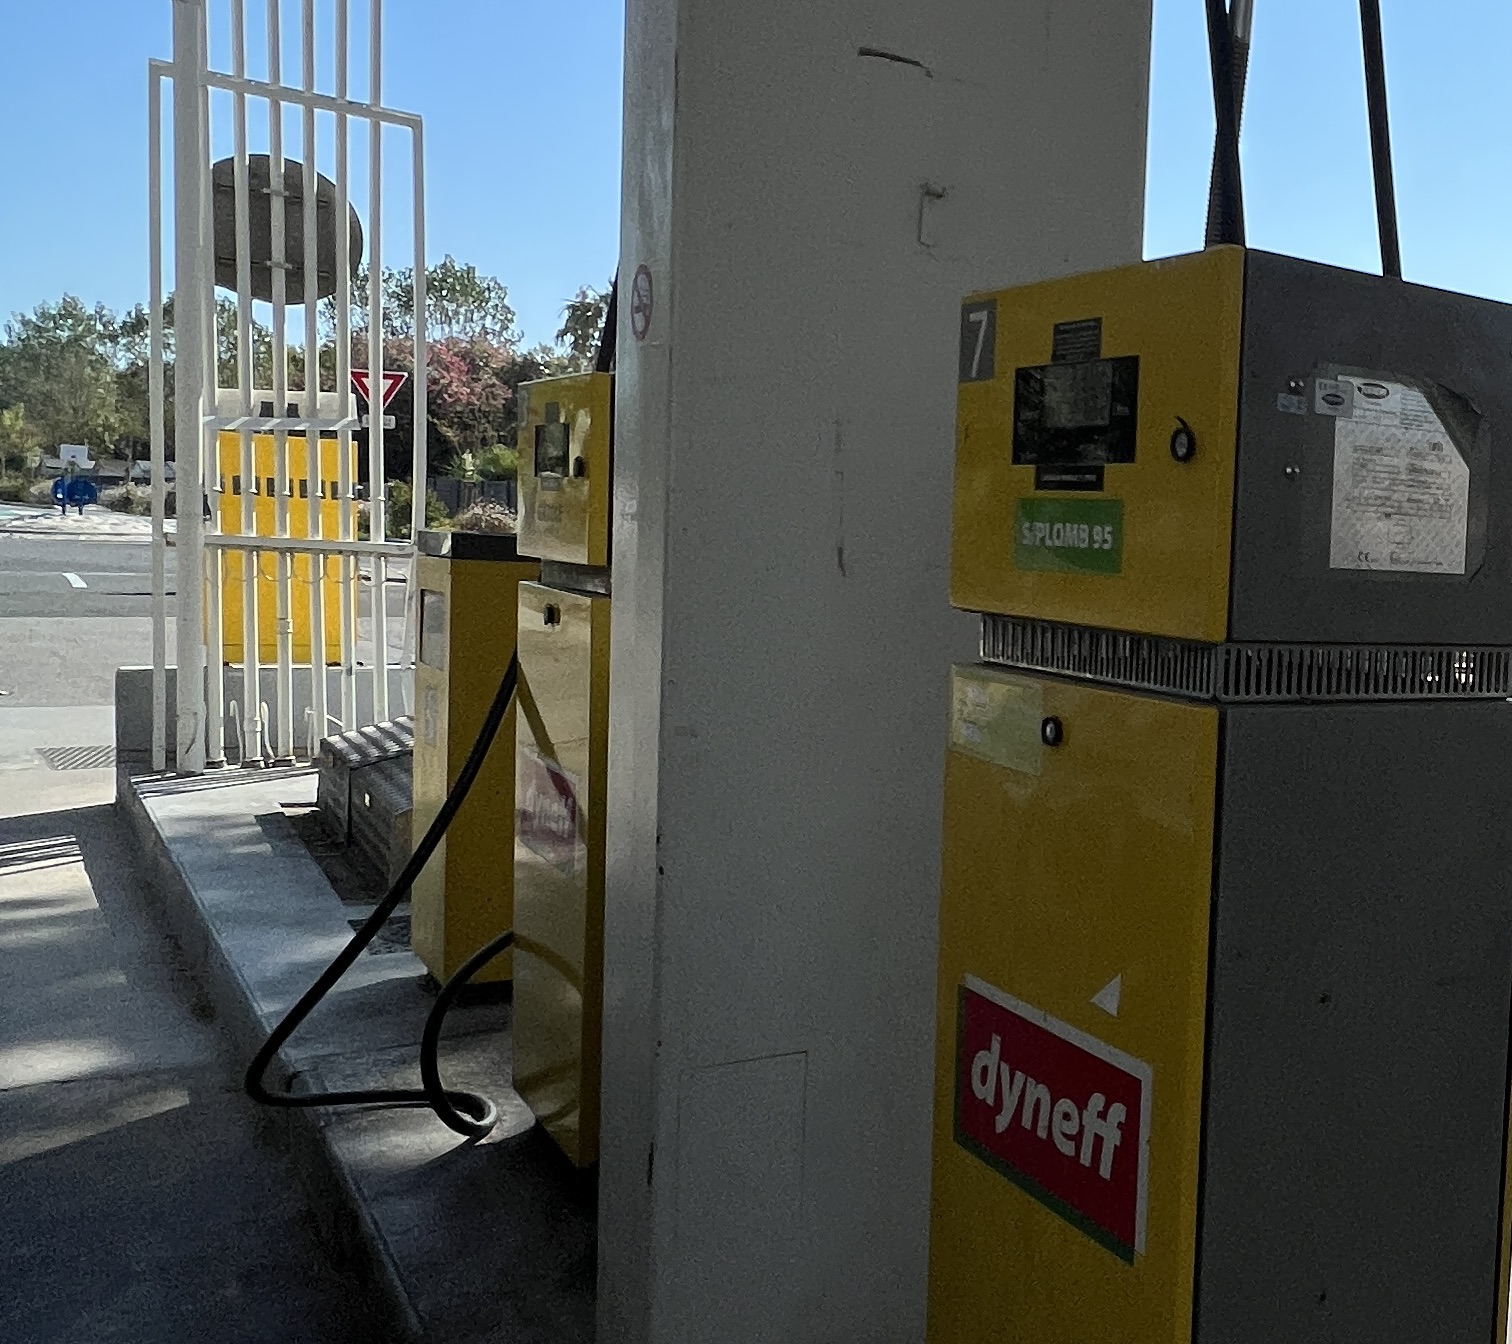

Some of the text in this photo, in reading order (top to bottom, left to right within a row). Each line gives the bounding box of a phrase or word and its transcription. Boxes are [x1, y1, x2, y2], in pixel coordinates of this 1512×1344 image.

[969, 310, 988, 378] 7
[1092, 524, 1114, 550] 95
[971, 1032, 1127, 1181] dyneff
